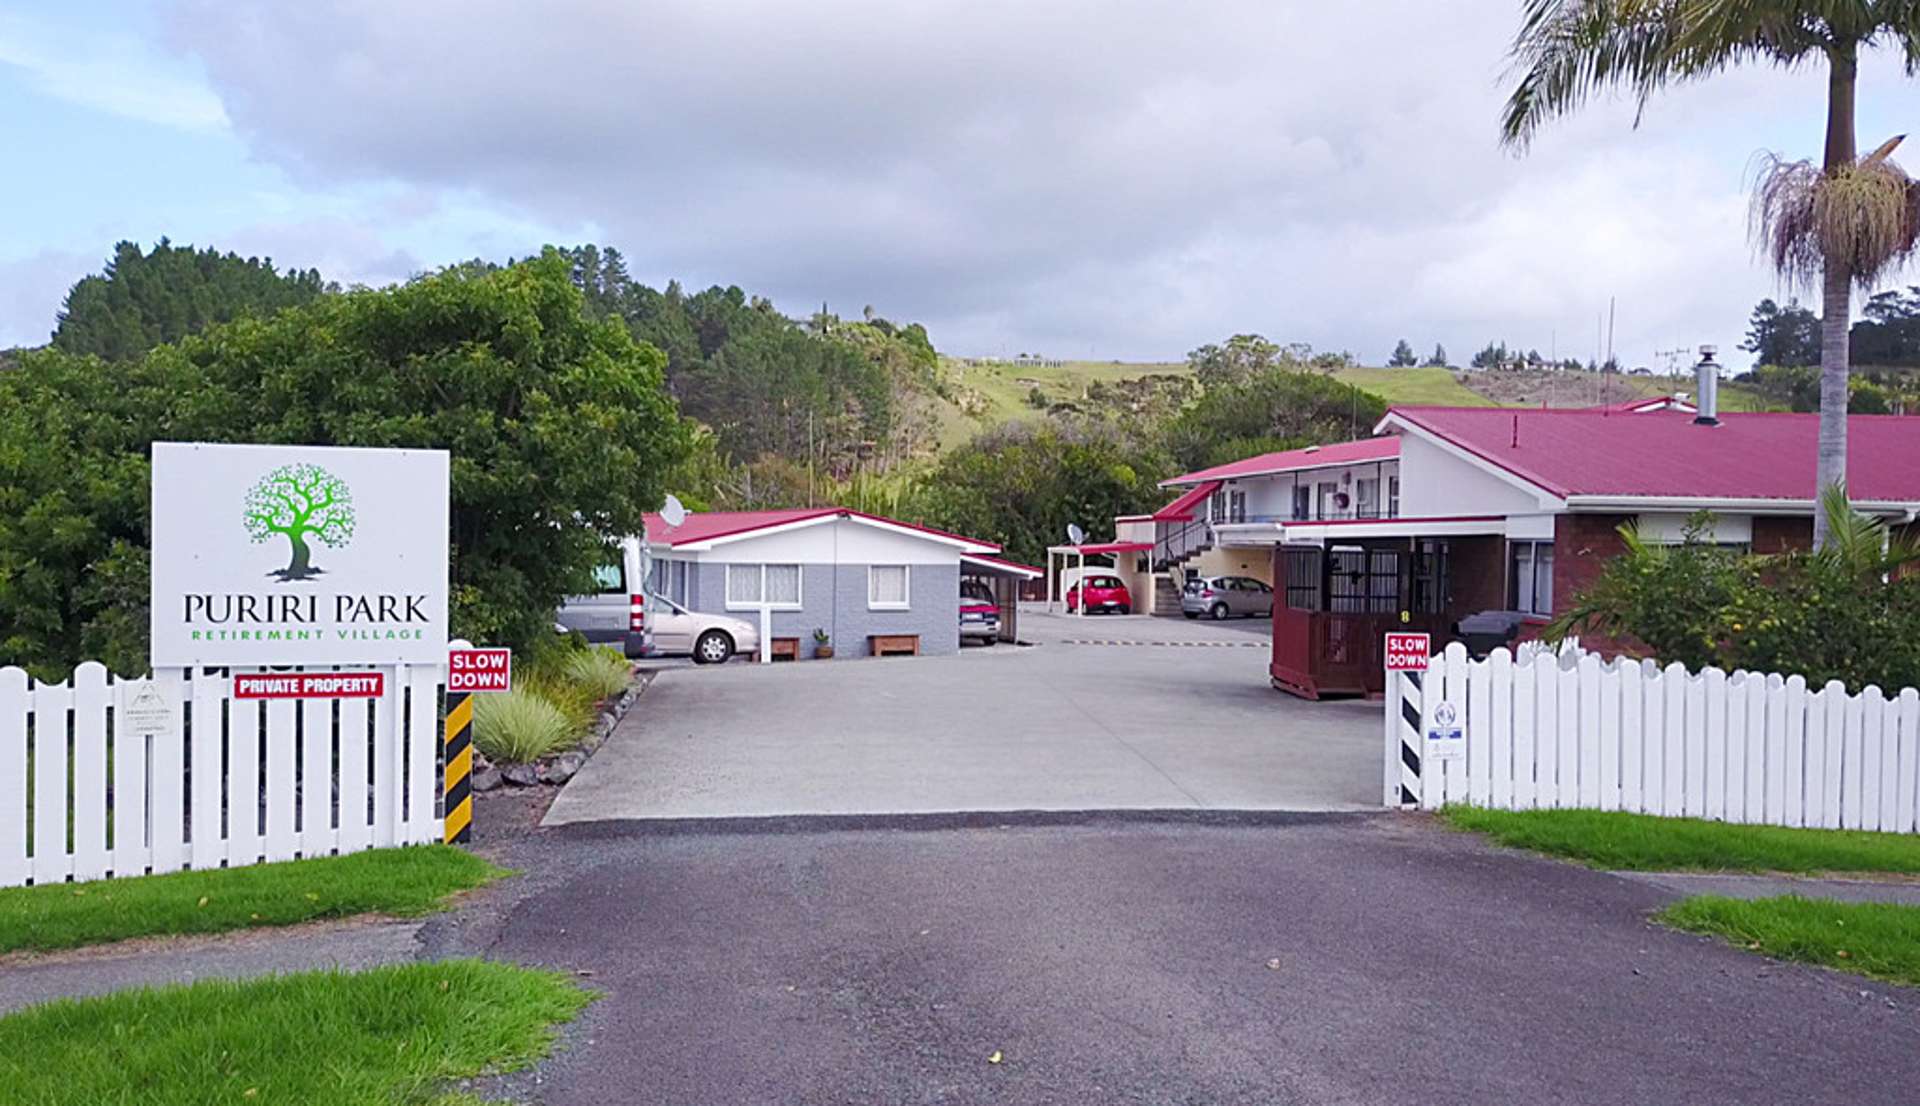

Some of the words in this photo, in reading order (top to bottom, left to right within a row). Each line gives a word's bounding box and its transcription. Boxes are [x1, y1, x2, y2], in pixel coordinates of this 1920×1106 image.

[184, 594, 316, 623] PURIRI
[335, 594, 429, 623] PARK
[1401, 610, 1410, 623] 8
[191, 629, 323, 640] RETIREMENT
[337, 629, 422, 640] VILLAGE
[1390, 639, 1426, 651] SLOW
[453, 654, 505, 669] SLOW
[1389, 654, 1426, 666] DOWN
[239, 678, 299, 693] PRIVATE
[303, 677, 378, 693] PROPERTY
[451, 672, 506, 687] DOWN
